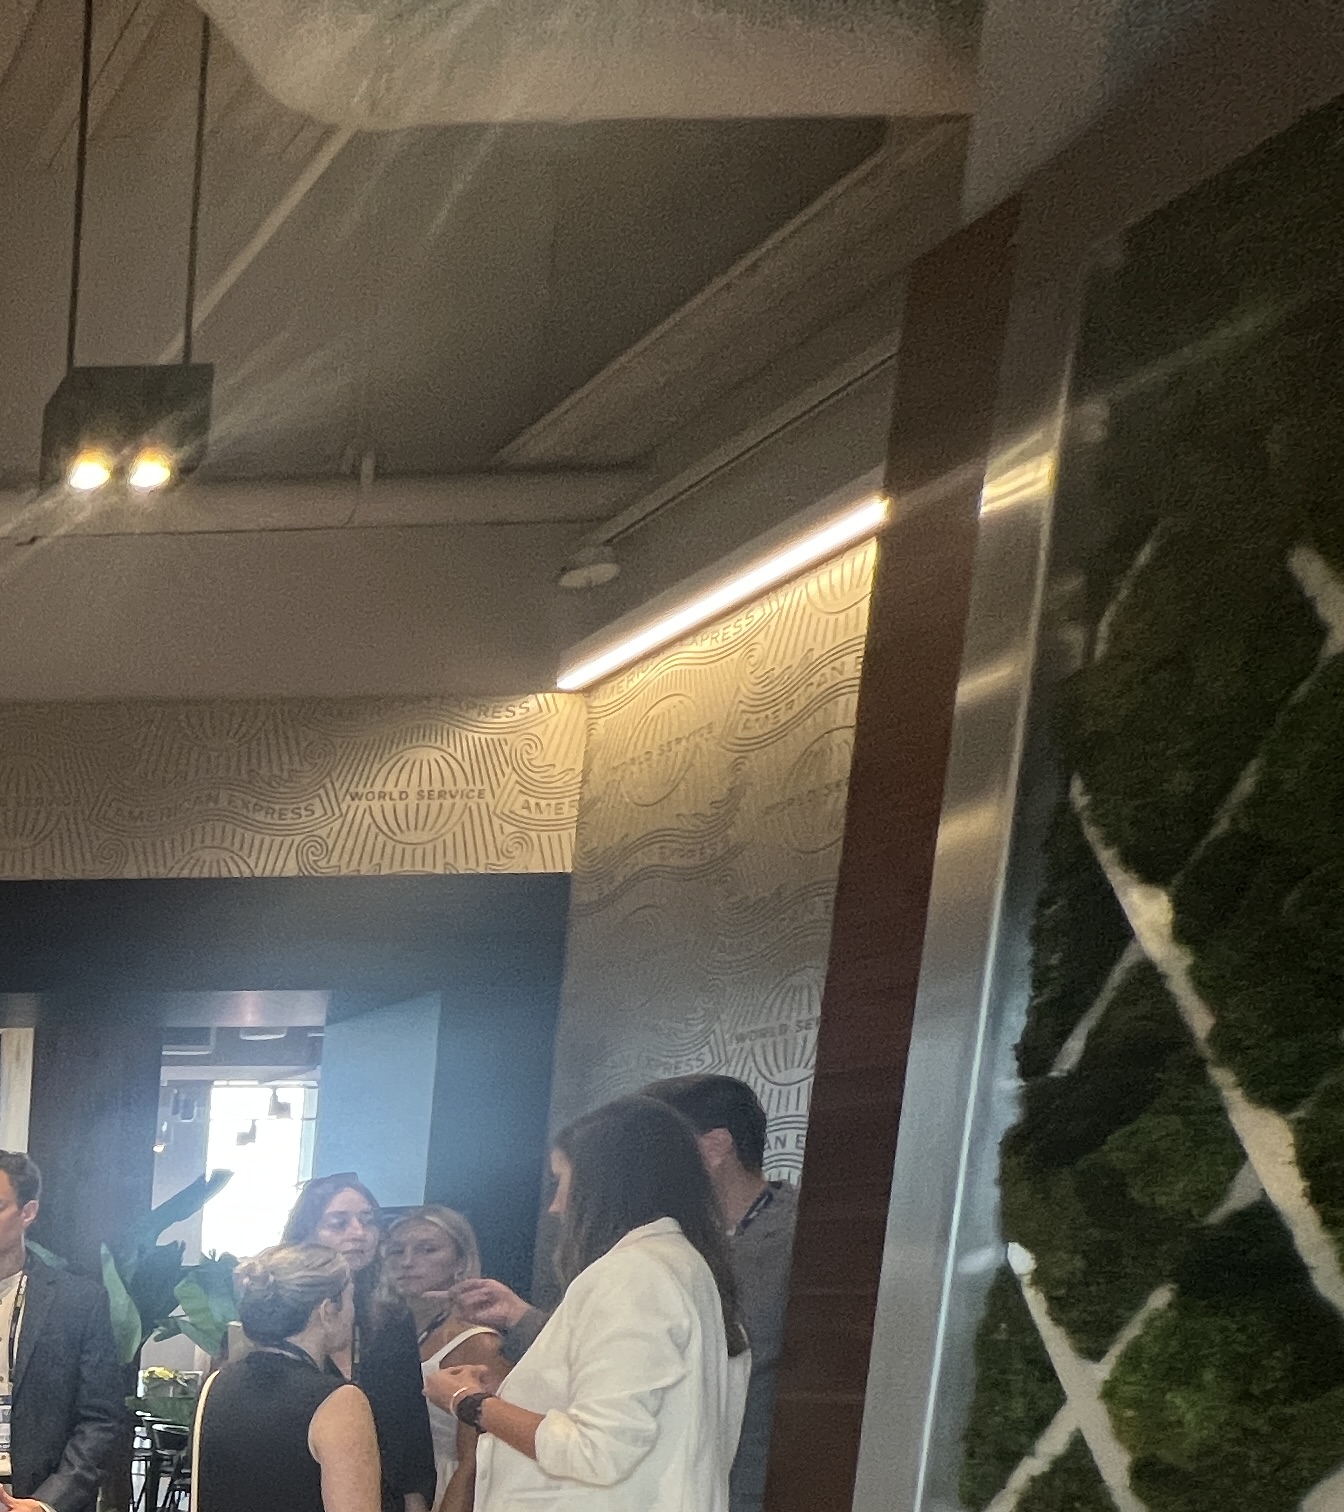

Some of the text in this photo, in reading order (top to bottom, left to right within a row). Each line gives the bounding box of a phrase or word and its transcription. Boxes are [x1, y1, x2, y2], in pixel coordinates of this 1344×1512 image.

[349, 788, 486, 802] WORLD SERVICE
[223, 793, 317, 822] EXPRESS
[521, 799, 578, 816] AMER
